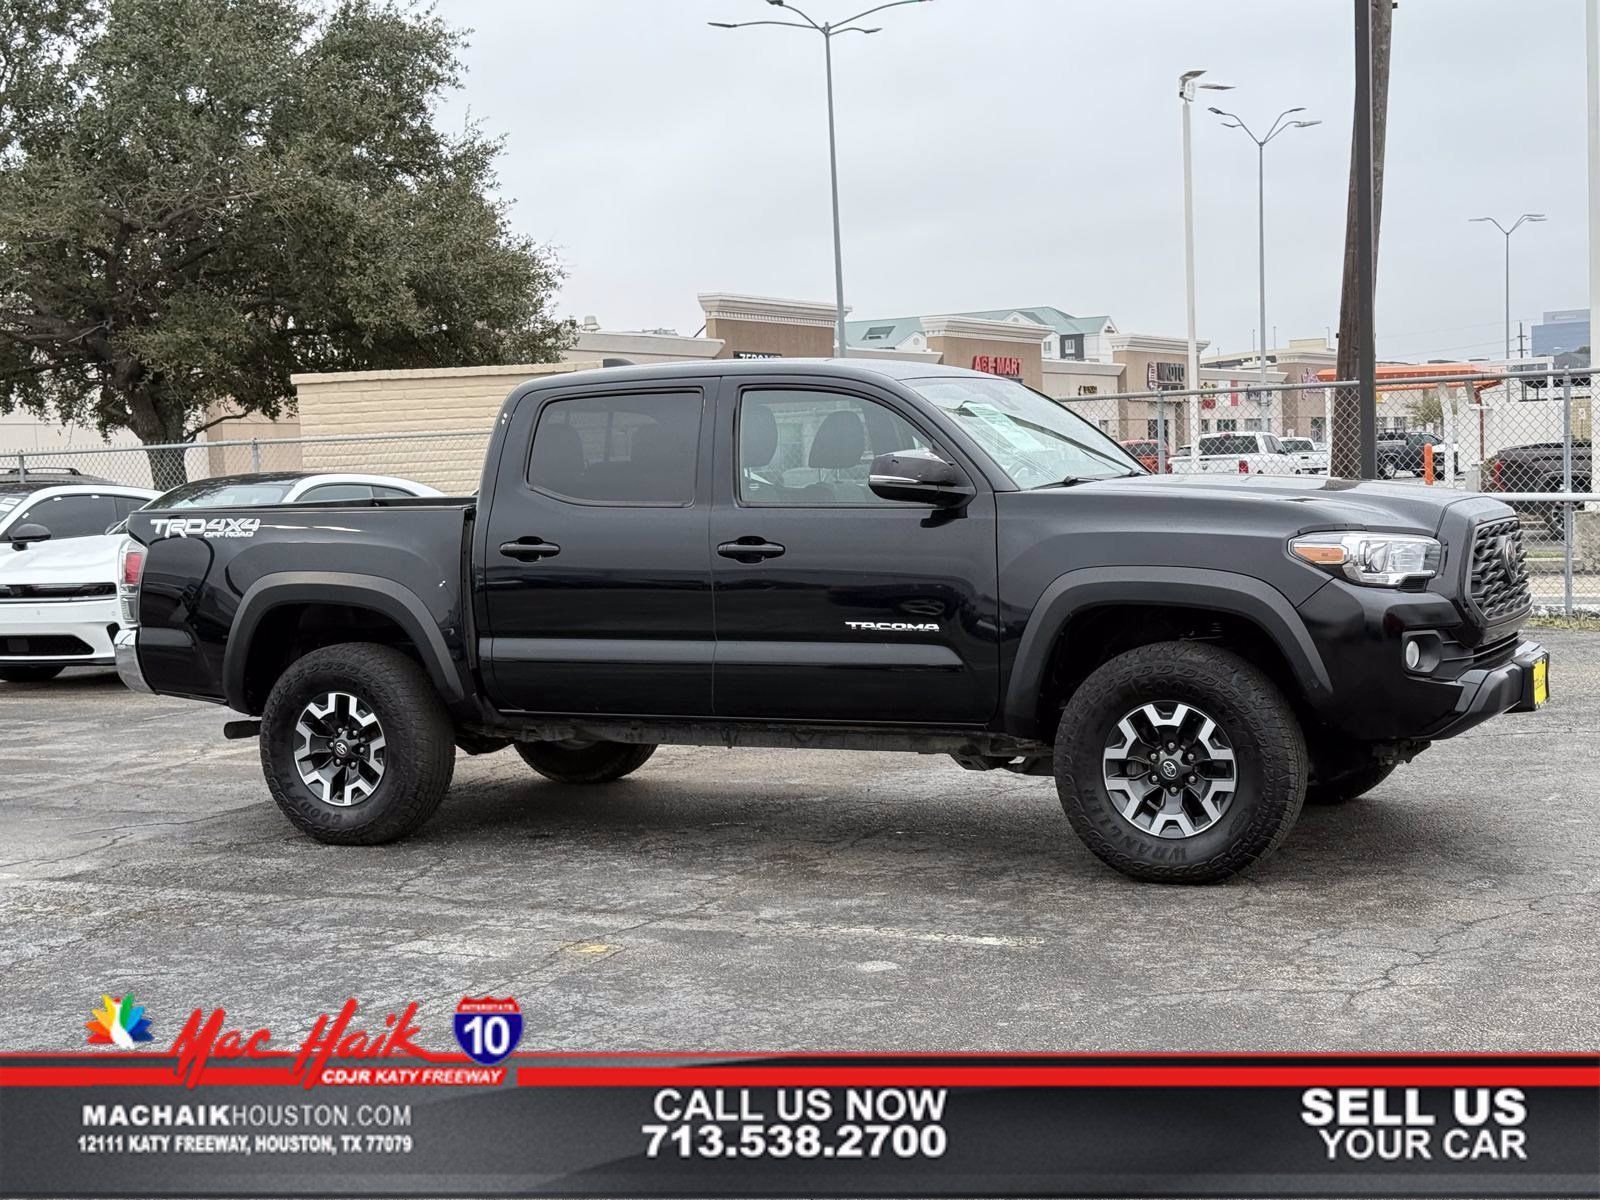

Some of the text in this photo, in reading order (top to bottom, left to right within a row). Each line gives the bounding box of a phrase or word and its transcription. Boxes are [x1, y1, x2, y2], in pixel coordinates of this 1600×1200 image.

[996, 357, 1023, 376] MART
[150, 518, 206, 538] TRD
[845, 621, 940, 632] TACOMA
